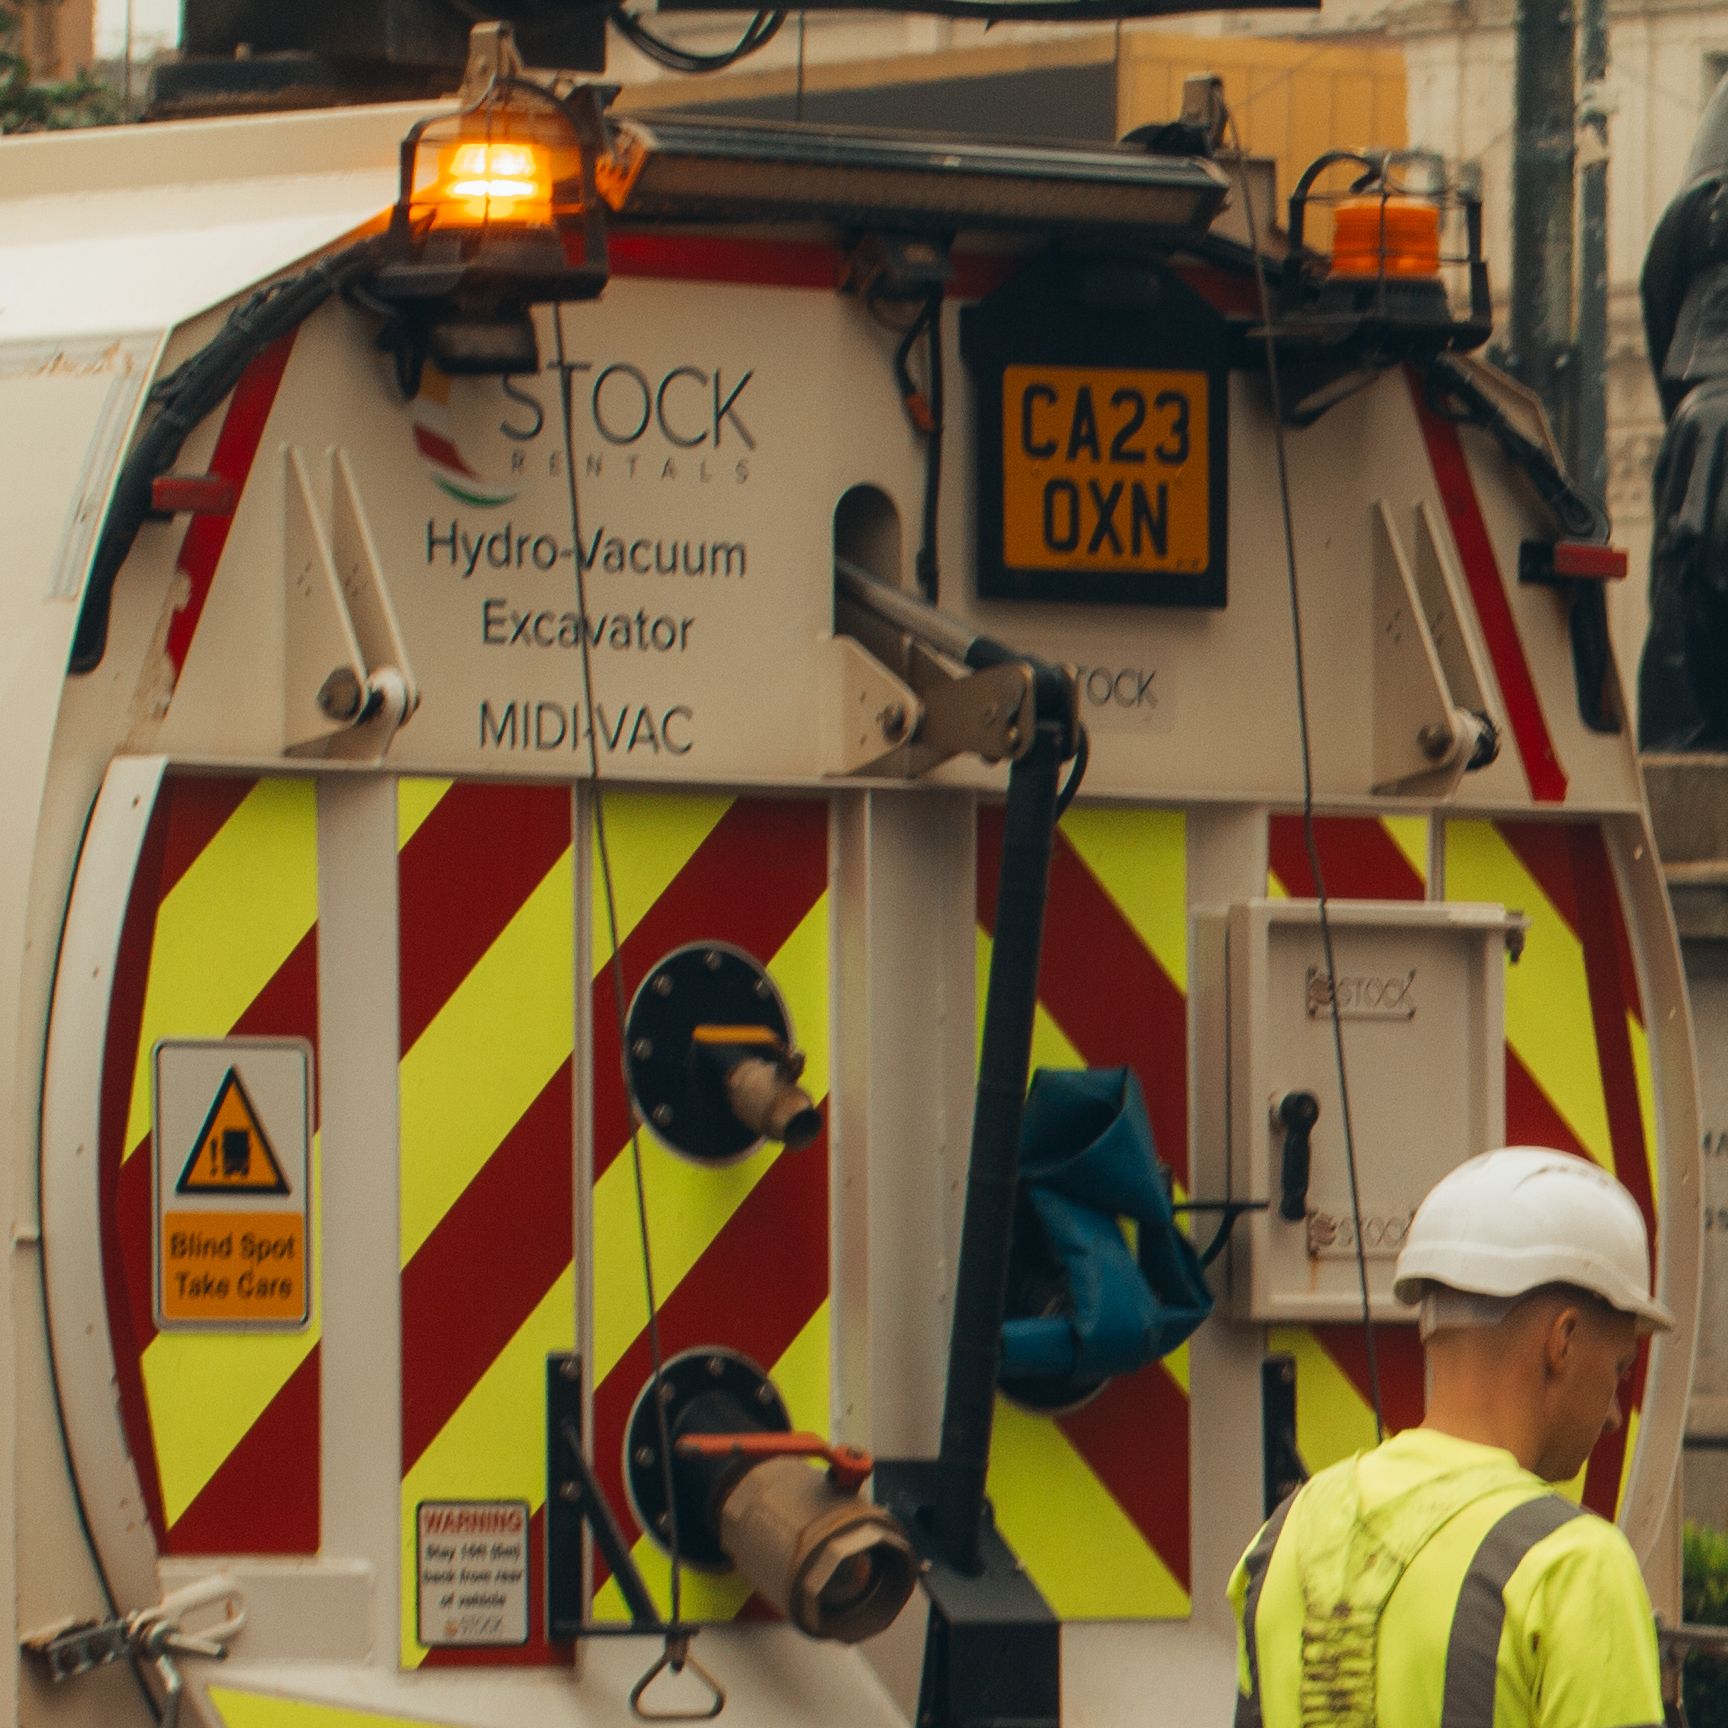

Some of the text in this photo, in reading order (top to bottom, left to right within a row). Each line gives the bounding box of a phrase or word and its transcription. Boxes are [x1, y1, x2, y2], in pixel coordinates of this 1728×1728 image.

[500, 360, 757, 451] STOCK
[1021, 383, 1190, 467] CA23
[511, 451, 749, 483] RENTALS
[1043, 477, 1168, 558] OXN
[425, 517, 749, 579] Hydro-Vacuum
[481, 597, 696, 653] Excavator
[171, 1231, 296, 1266] Blind Spot
[175, 1270, 292, 1299] Take Care
[425, 1510, 523, 1534] WARNING
